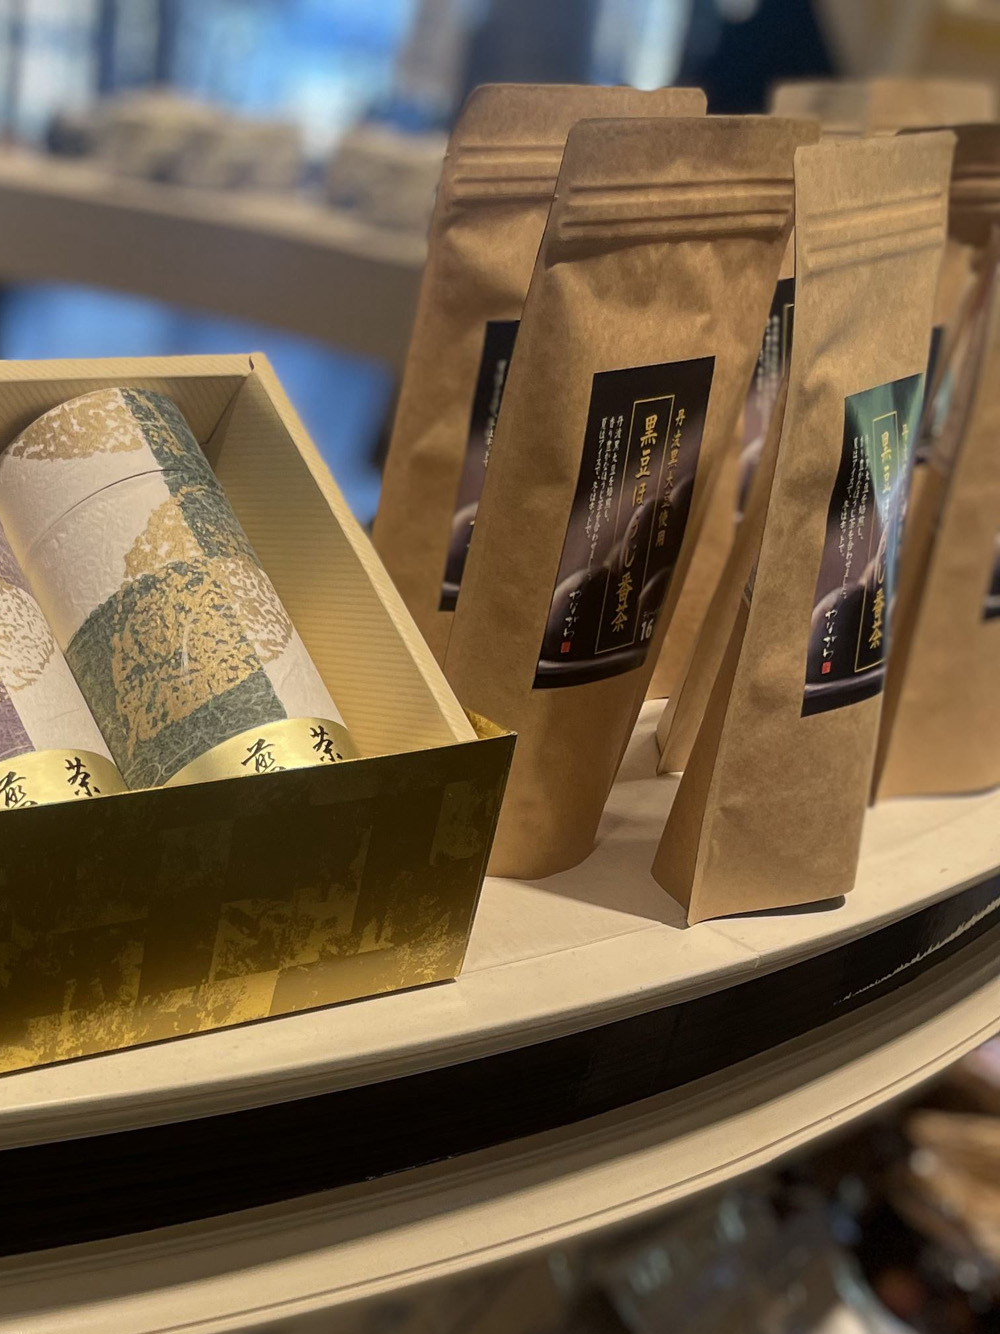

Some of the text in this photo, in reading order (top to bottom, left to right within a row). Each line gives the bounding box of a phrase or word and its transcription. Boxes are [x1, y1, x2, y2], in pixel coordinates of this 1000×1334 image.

[610, 414, 658, 633] 黒豆ほうじ番茶
[240, 725, 343, 774] 煎茶
